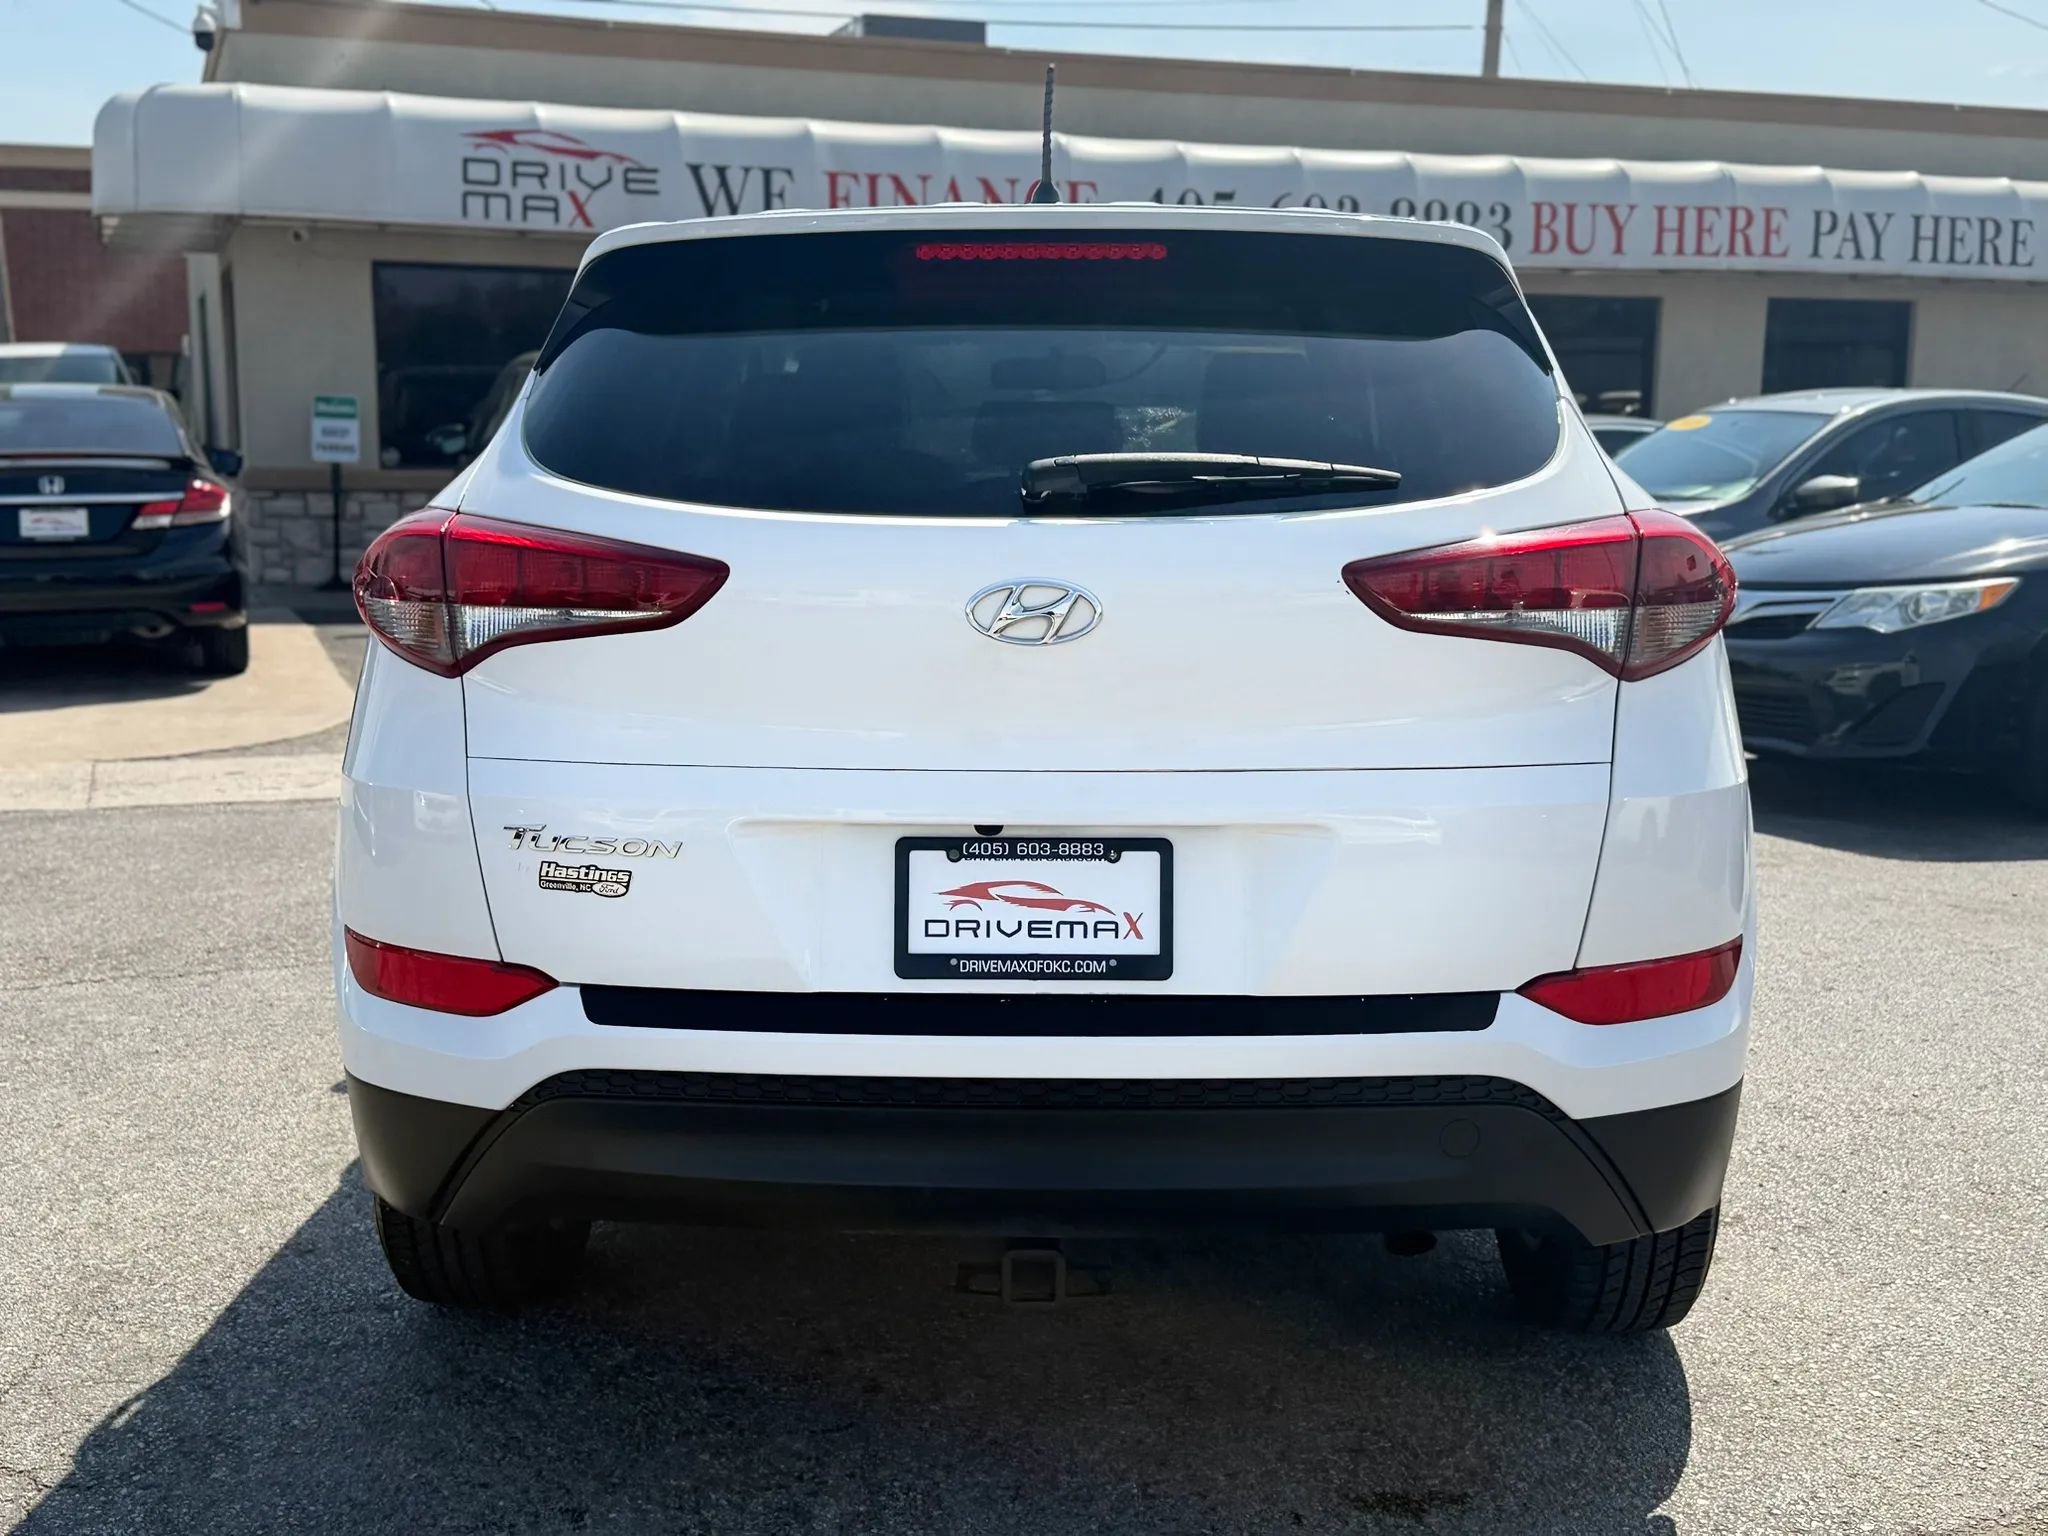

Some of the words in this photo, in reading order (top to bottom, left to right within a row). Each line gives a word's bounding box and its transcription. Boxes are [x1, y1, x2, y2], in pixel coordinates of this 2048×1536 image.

[462, 157, 661, 195] DRIVE
[685, 162, 796, 217] WE
[462, 190, 593, 228] MAX
[1530, 202, 1638, 256] BUY
[1652, 205, 1790, 259] HERE
[1808, 209, 1895, 261] PAY
[1908, 213, 2036, 268] HERE
[962, 842, 1009, 855] (405)
[1016, 842, 1104, 856] 603-8883
[579, 883, 592, 892] NC
[599, 884, 619, 894] Ford
[924, 911, 1144, 940] DRIVEMAX
[959, 959, 1107, 974] DRIVEMAXOFOKC.COM
